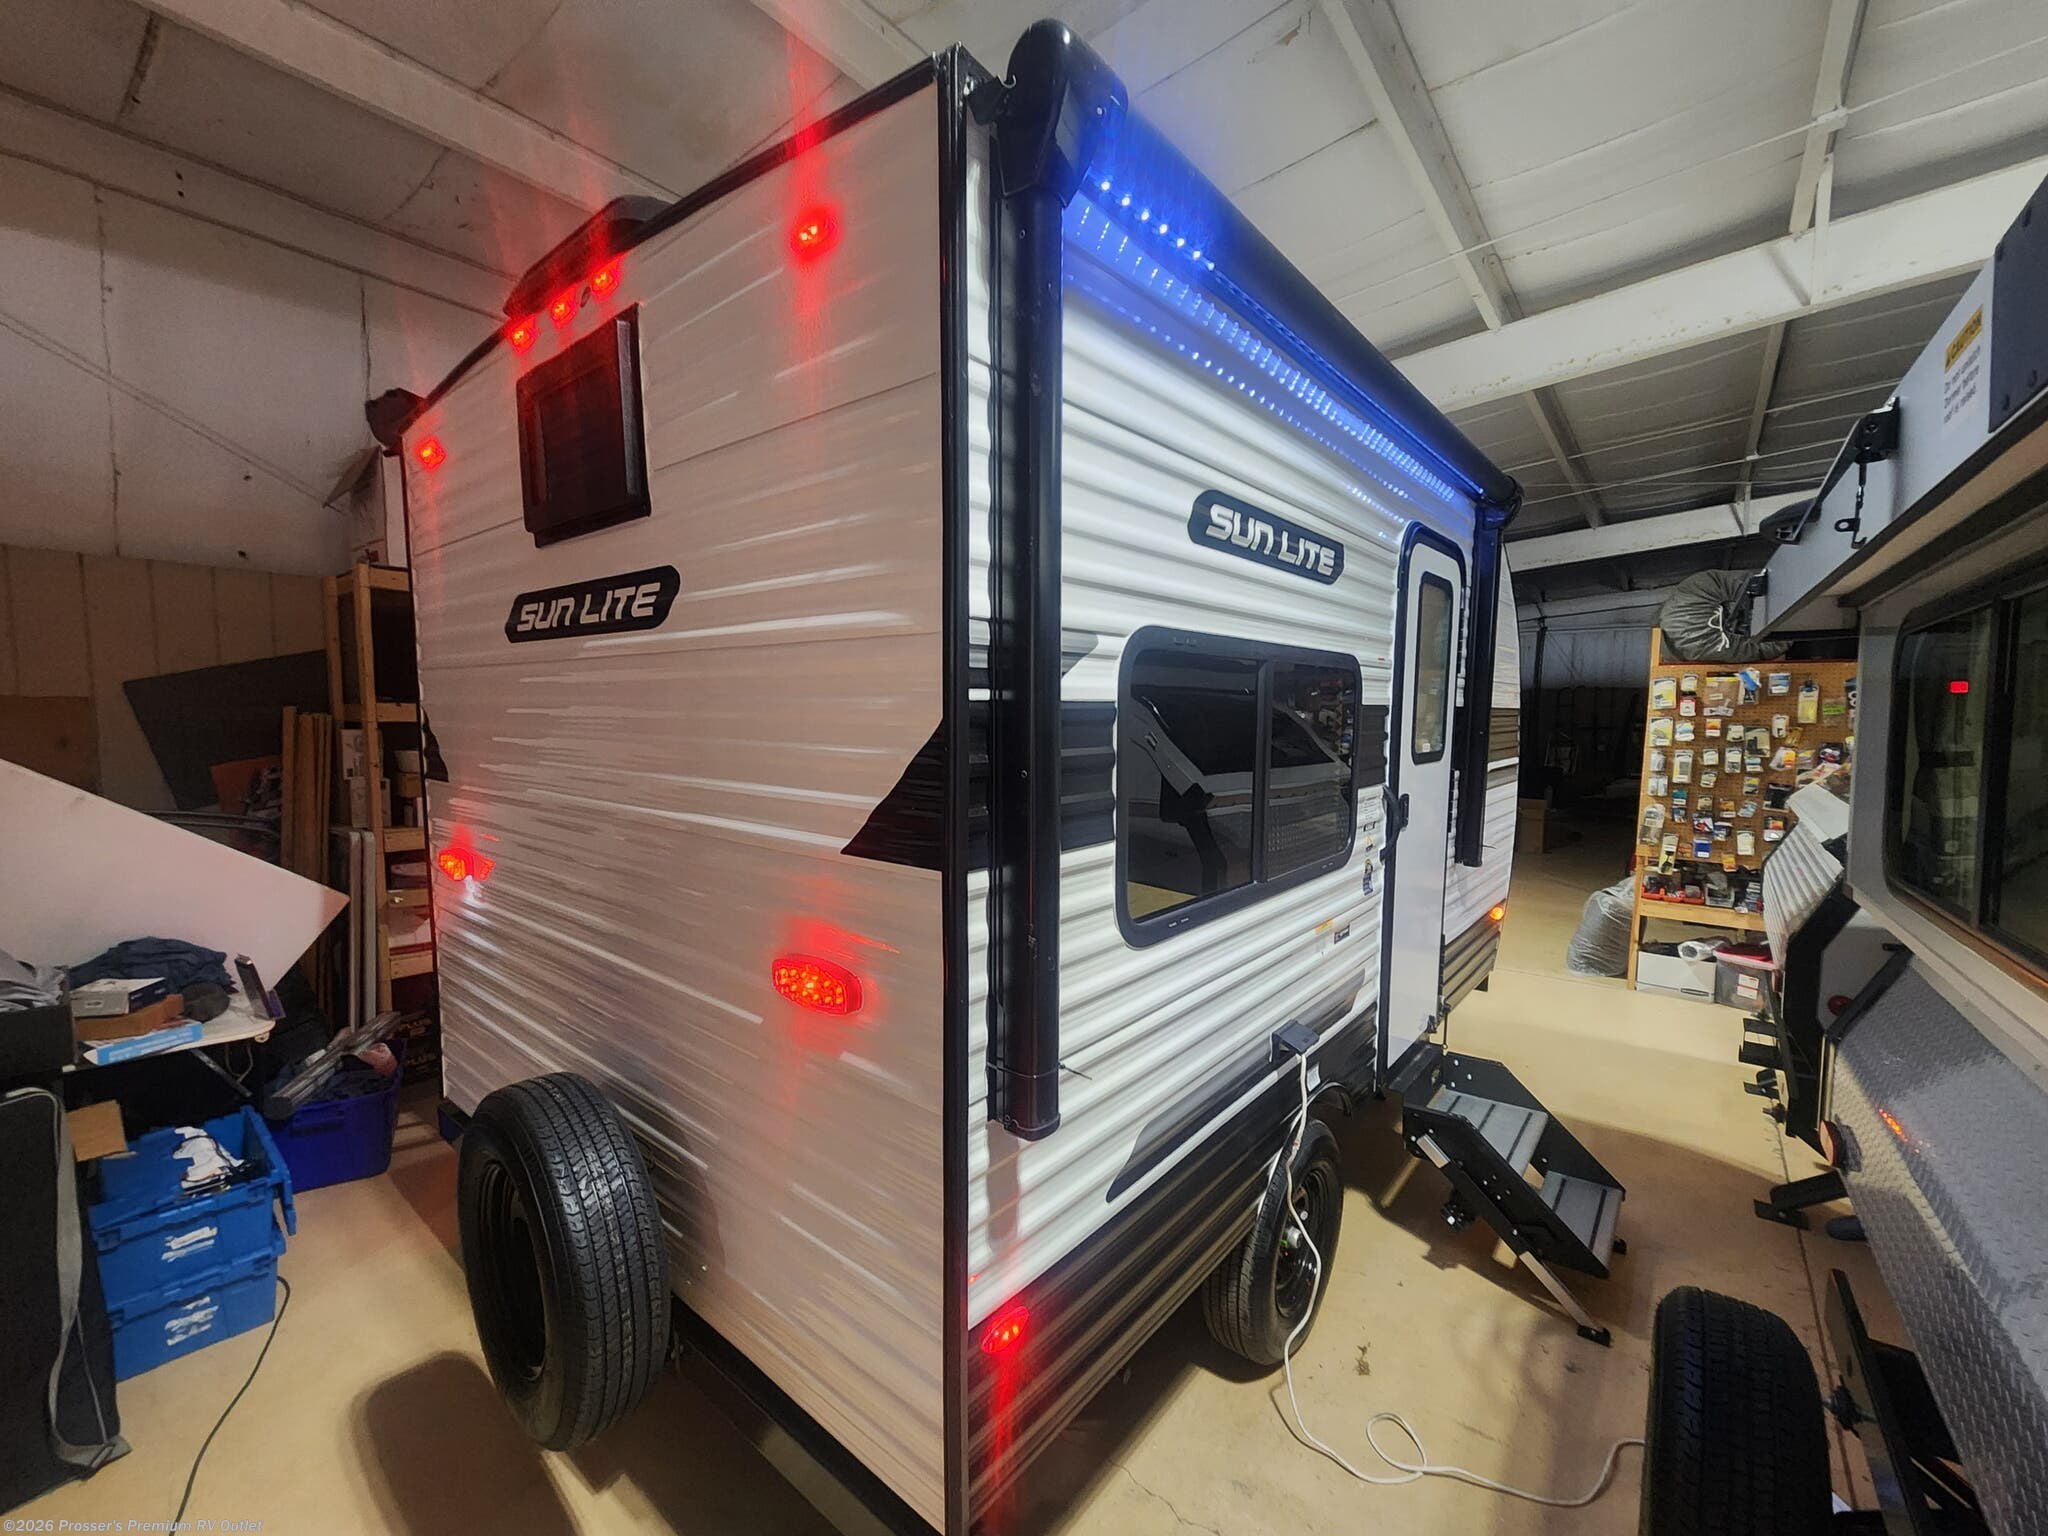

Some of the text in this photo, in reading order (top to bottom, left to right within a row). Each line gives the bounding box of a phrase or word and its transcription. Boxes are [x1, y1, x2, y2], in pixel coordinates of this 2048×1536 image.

[1205, 503, 1336, 576] SUN LITE
[516, 582, 661, 632] SUN LITE
